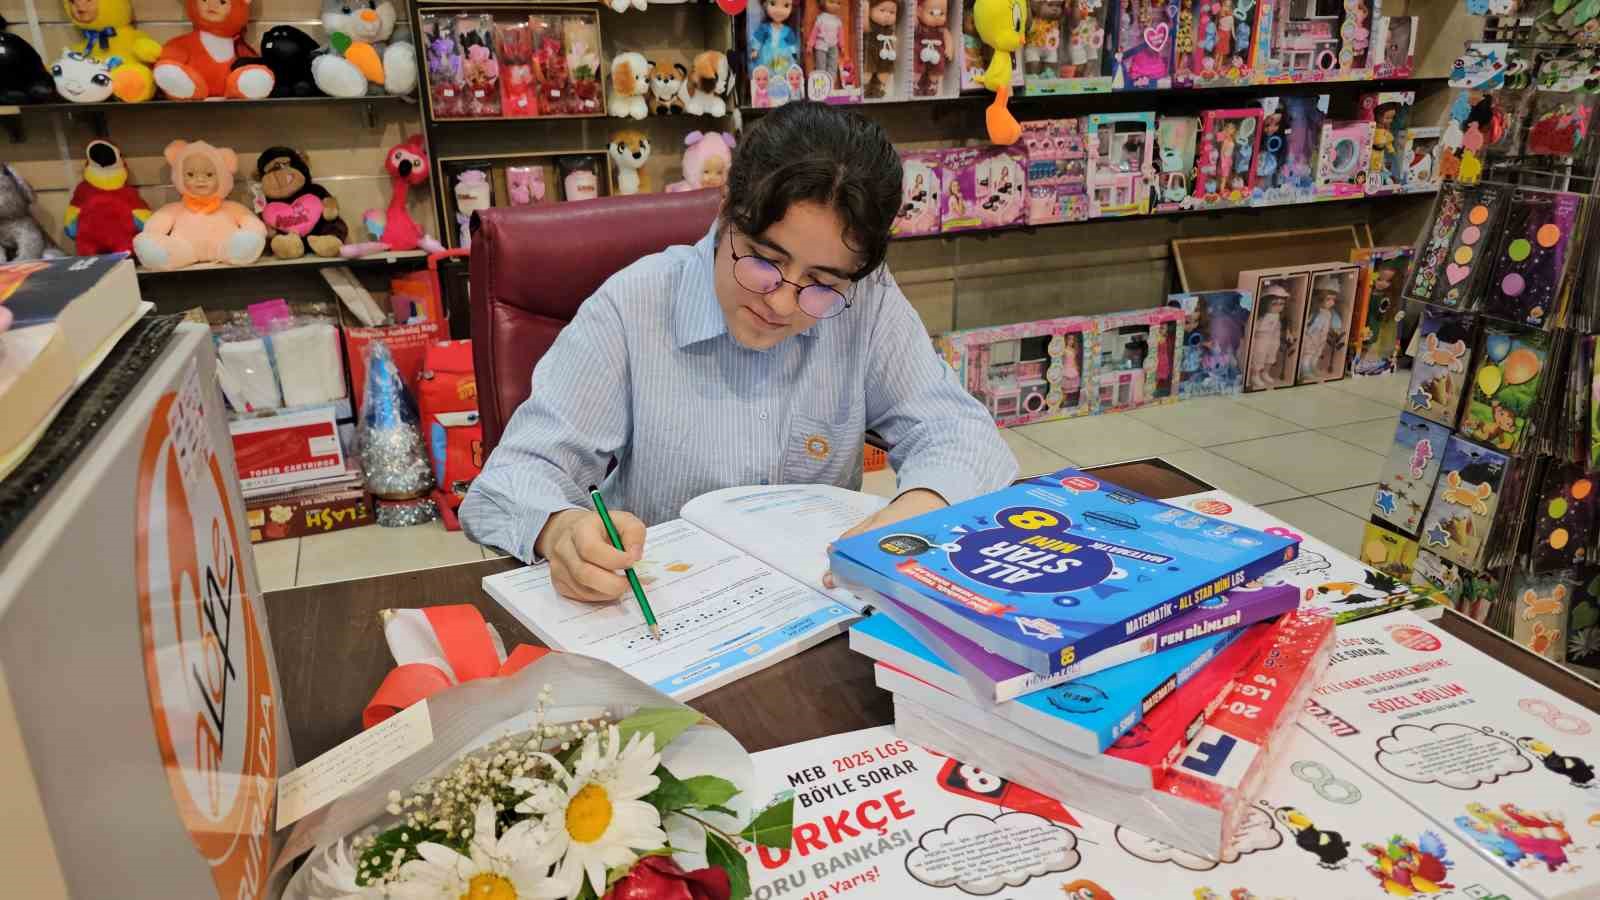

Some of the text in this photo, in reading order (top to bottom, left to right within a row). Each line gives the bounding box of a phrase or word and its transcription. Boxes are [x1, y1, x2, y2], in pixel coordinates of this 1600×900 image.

[250, 466, 280, 478] TONER
[1007, 510, 1059, 530] 8
[970, 558, 1044, 585] ALL
[979, 541, 1082, 574] STAR
[1126, 602, 1172, 635] MATEMATİK
[1179, 594, 1193, 610] ALL
[1194, 586, 1213, 603] STAR
[1231, 570, 1245, 587] LGS
[787, 740, 909, 787] MEB 2025 LGS
[798, 759, 918, 808] BÖYLE SORAR
[811, 828, 915, 879] BANKASI
[829, 865, 881, 896] Yarış!
